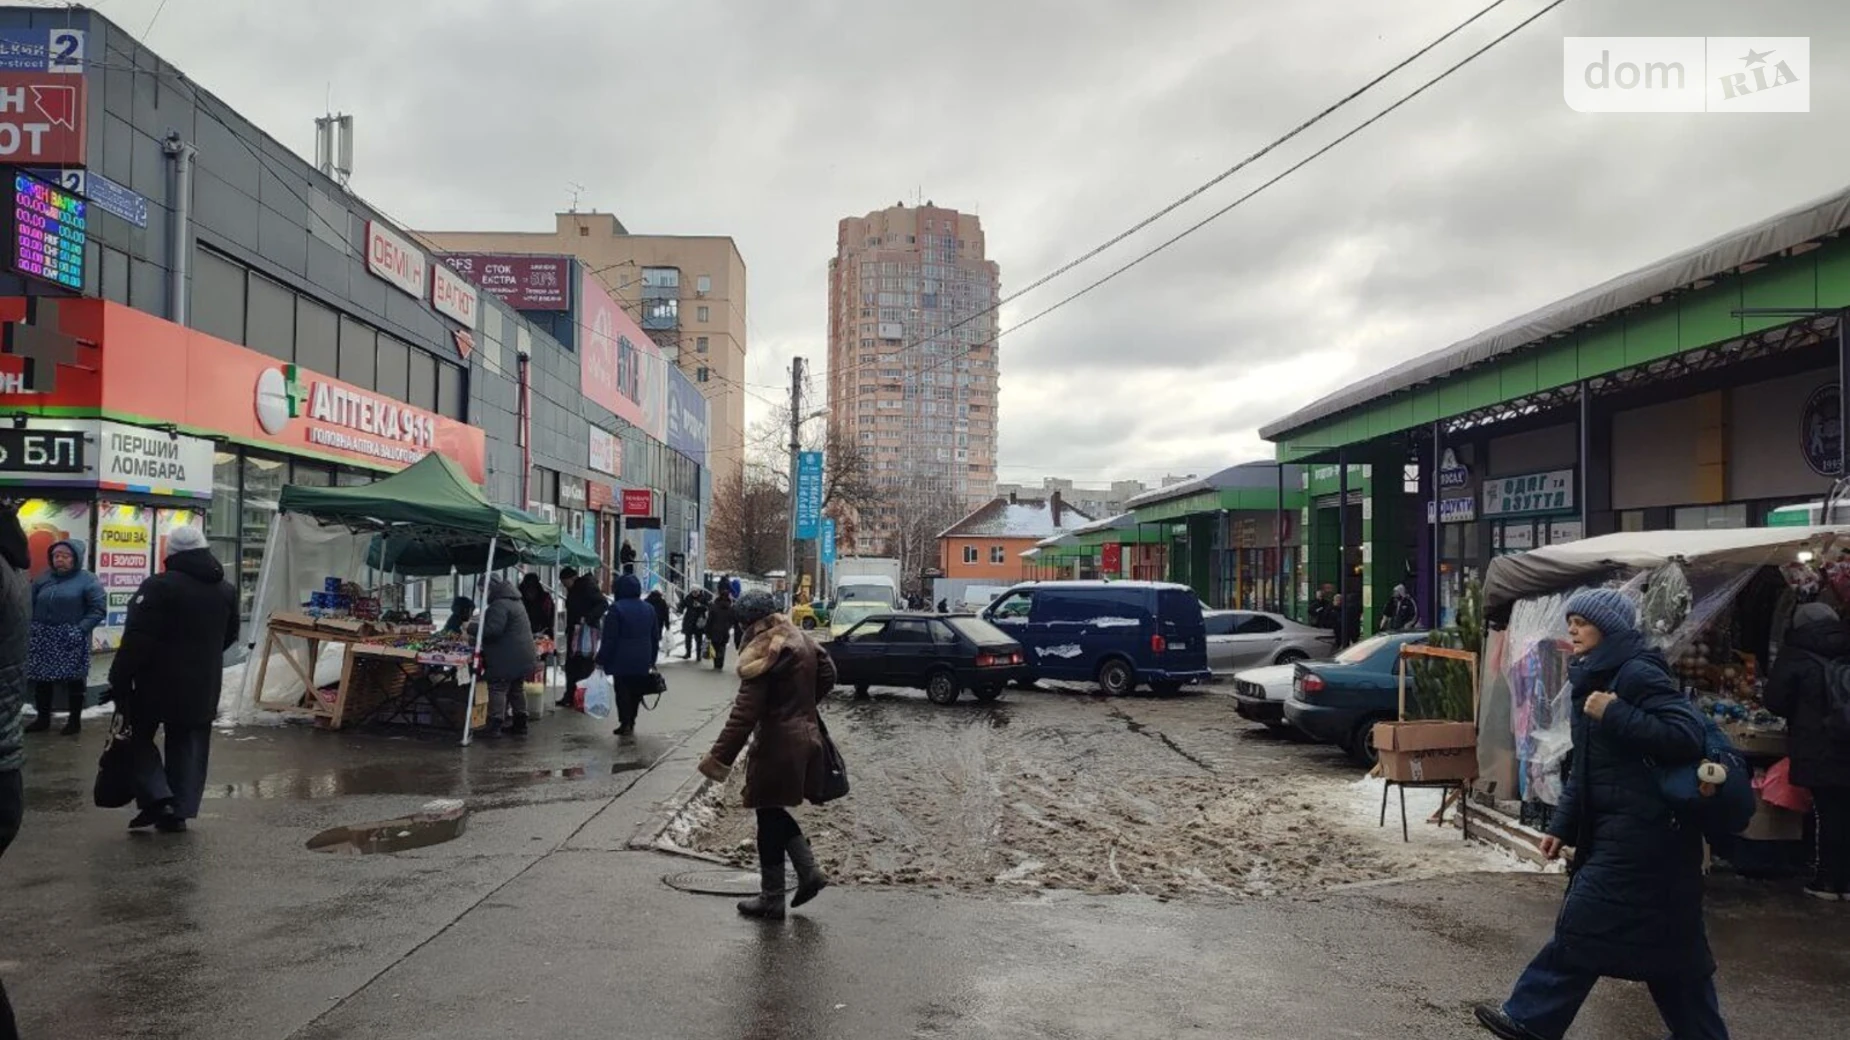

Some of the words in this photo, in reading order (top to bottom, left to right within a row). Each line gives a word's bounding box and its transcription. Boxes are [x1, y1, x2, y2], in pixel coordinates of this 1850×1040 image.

[55, 34, 78, 66] 2
[485, 264, 511, 273] СТОК
[482, 275, 517, 284] ЕКСТРА
[312, 382, 402, 442] АПТЕКА
[24, 436, 75, 466] БЛ
[111, 455, 186, 481] ЛОМБАРД
[1504, 475, 1548, 495] ОДЯГ
[1553, 478, 1565, 488] ТА
[1429, 498, 1474, 517] ПОДУКТИ
[1502, 491, 1566, 511] ВЗУТТЯ
